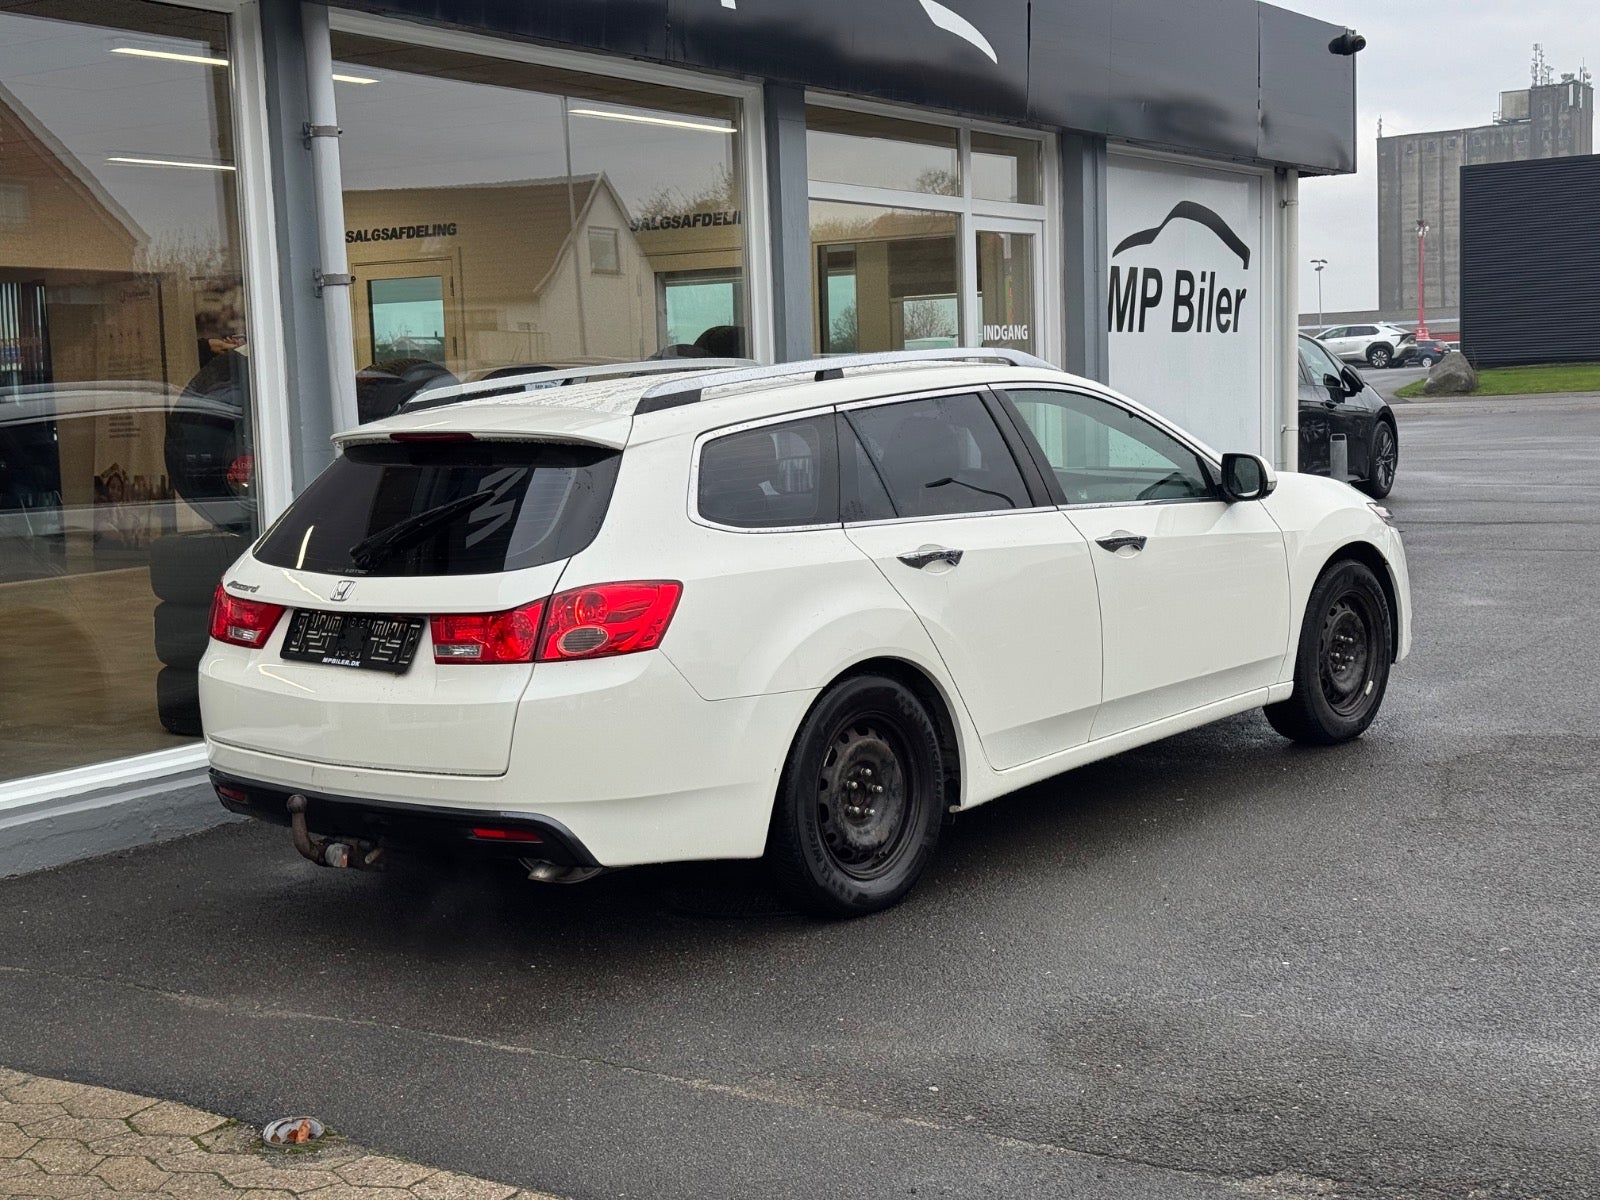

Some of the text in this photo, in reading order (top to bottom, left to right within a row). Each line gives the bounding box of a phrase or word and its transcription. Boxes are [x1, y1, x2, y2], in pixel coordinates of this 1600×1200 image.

[629, 210, 742, 232] SALGSAFDELI
[345, 222, 457, 243] SALGSAFDELING
[1108, 265, 1247, 334] MP Biler
[983, 324, 1029, 341] INDGANG
[321, 657, 361, 667] MPBILER.DK
